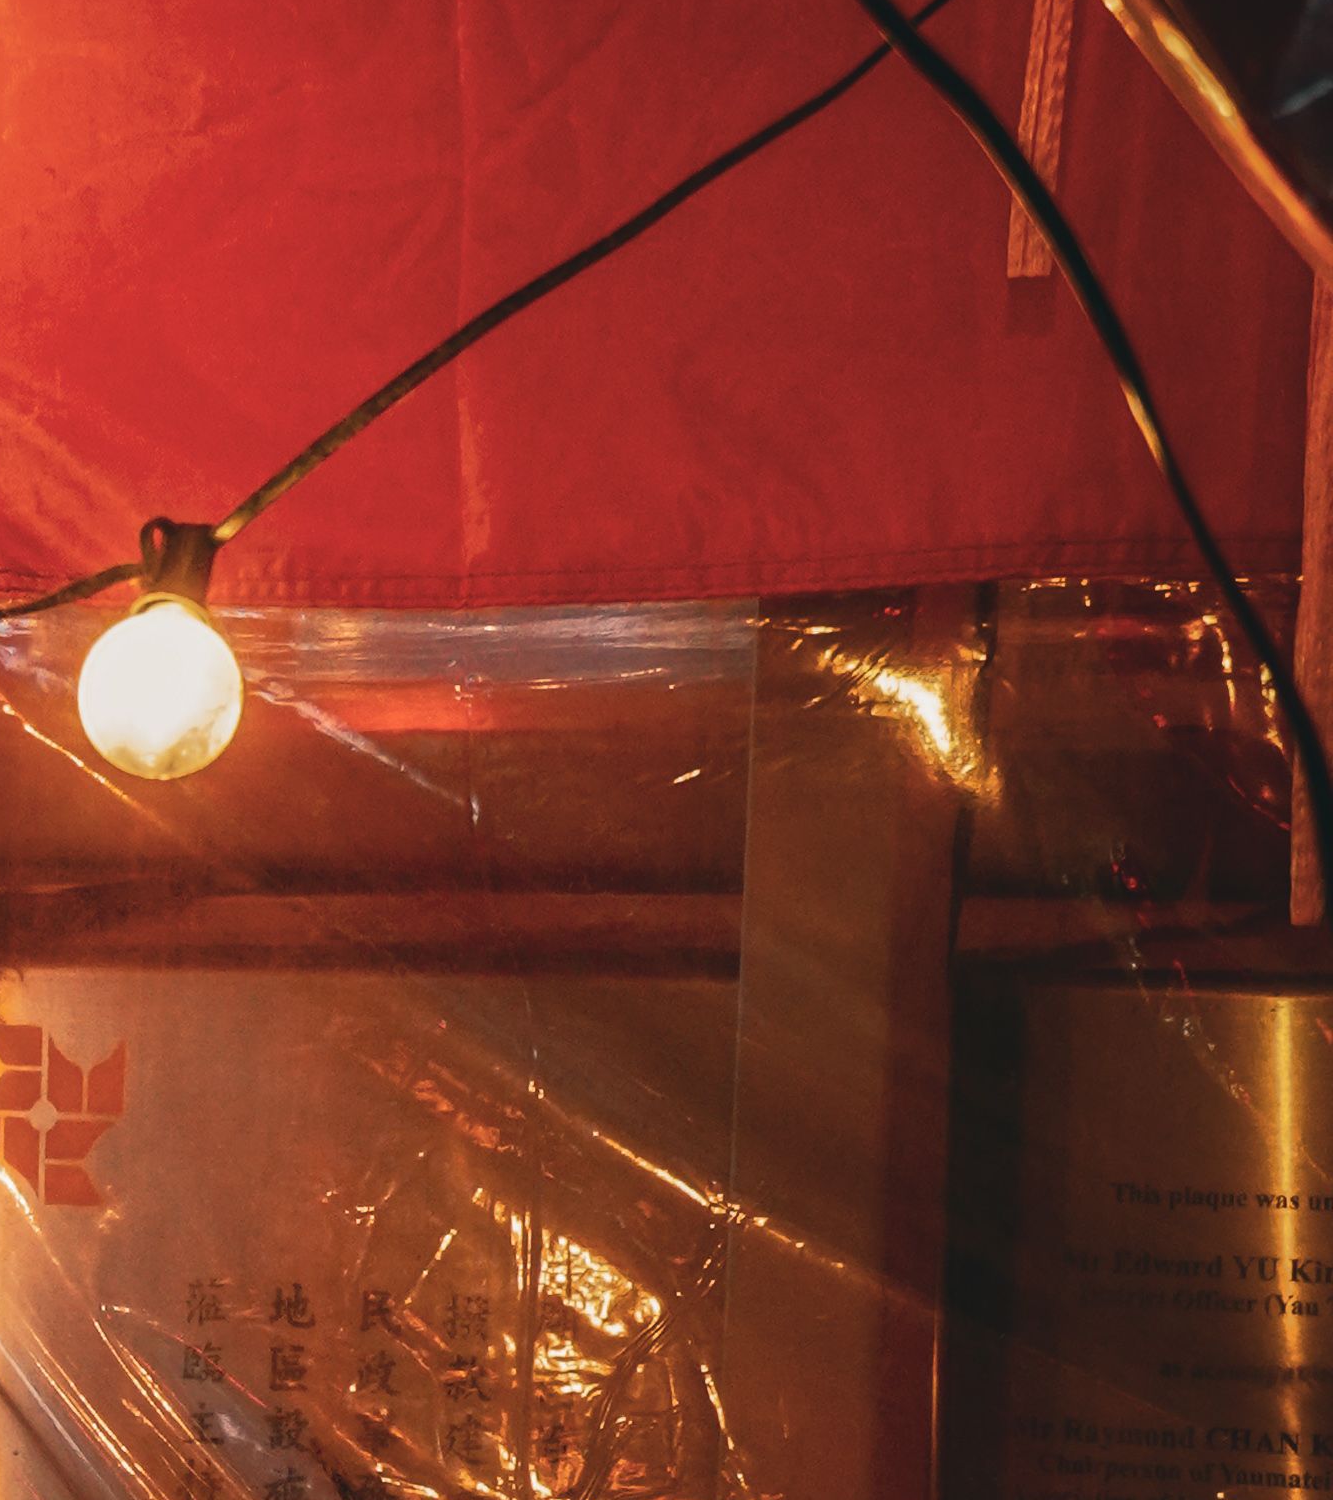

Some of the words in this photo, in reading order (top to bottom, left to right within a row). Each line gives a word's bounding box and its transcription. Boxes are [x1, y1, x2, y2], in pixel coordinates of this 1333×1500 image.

[1255, 1191, 1301, 1211] was
[1232, 1255, 1279, 1283] YU
[1204, 1426, 1299, 1456] CHAN
